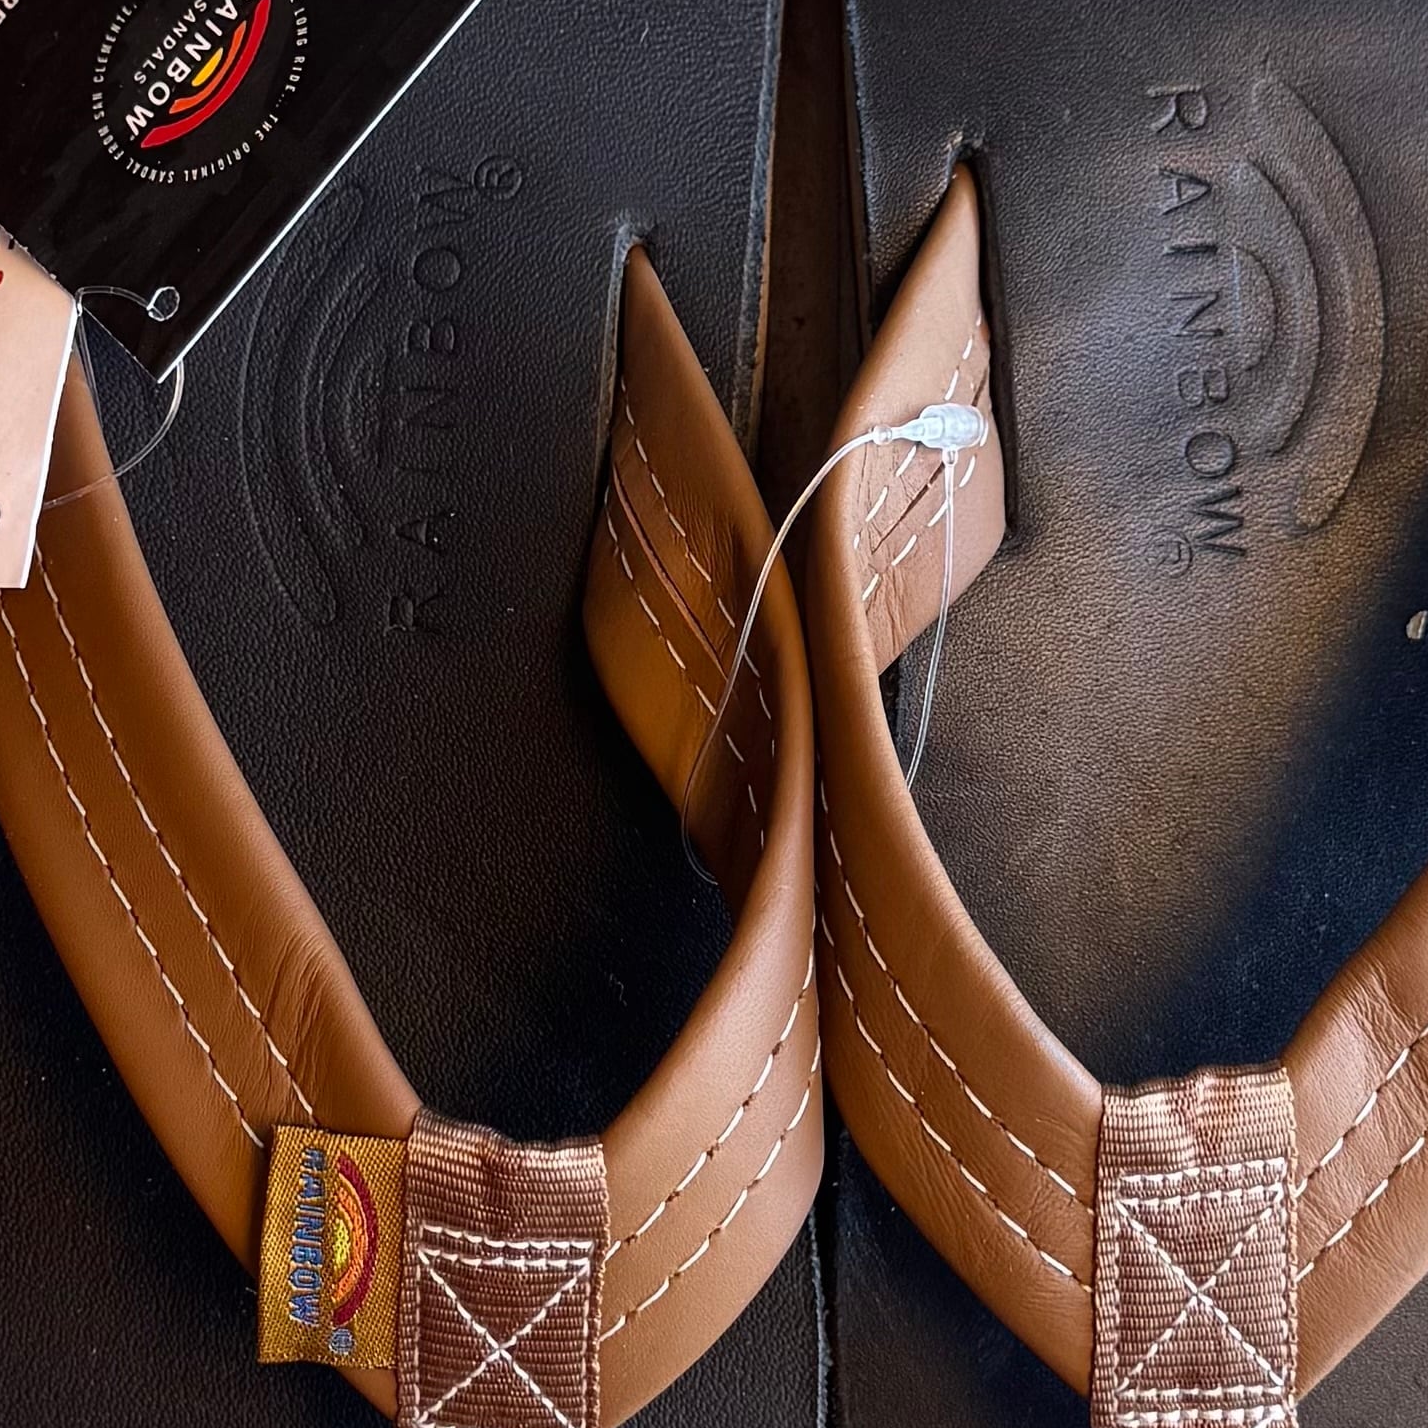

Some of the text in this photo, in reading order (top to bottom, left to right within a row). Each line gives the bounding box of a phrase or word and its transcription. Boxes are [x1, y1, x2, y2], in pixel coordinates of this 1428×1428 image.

[293, 7, 308, 46] LONG
[92, 92, 105, 121] SAN
[98, 125, 125, 161] FROM
[255, 113, 279, 142] THE
[125, 156, 175, 184] SANDAL
[184, 141, 251, 182] ORIGINAL
[288, 1146, 326, 1328] RAINBOW
